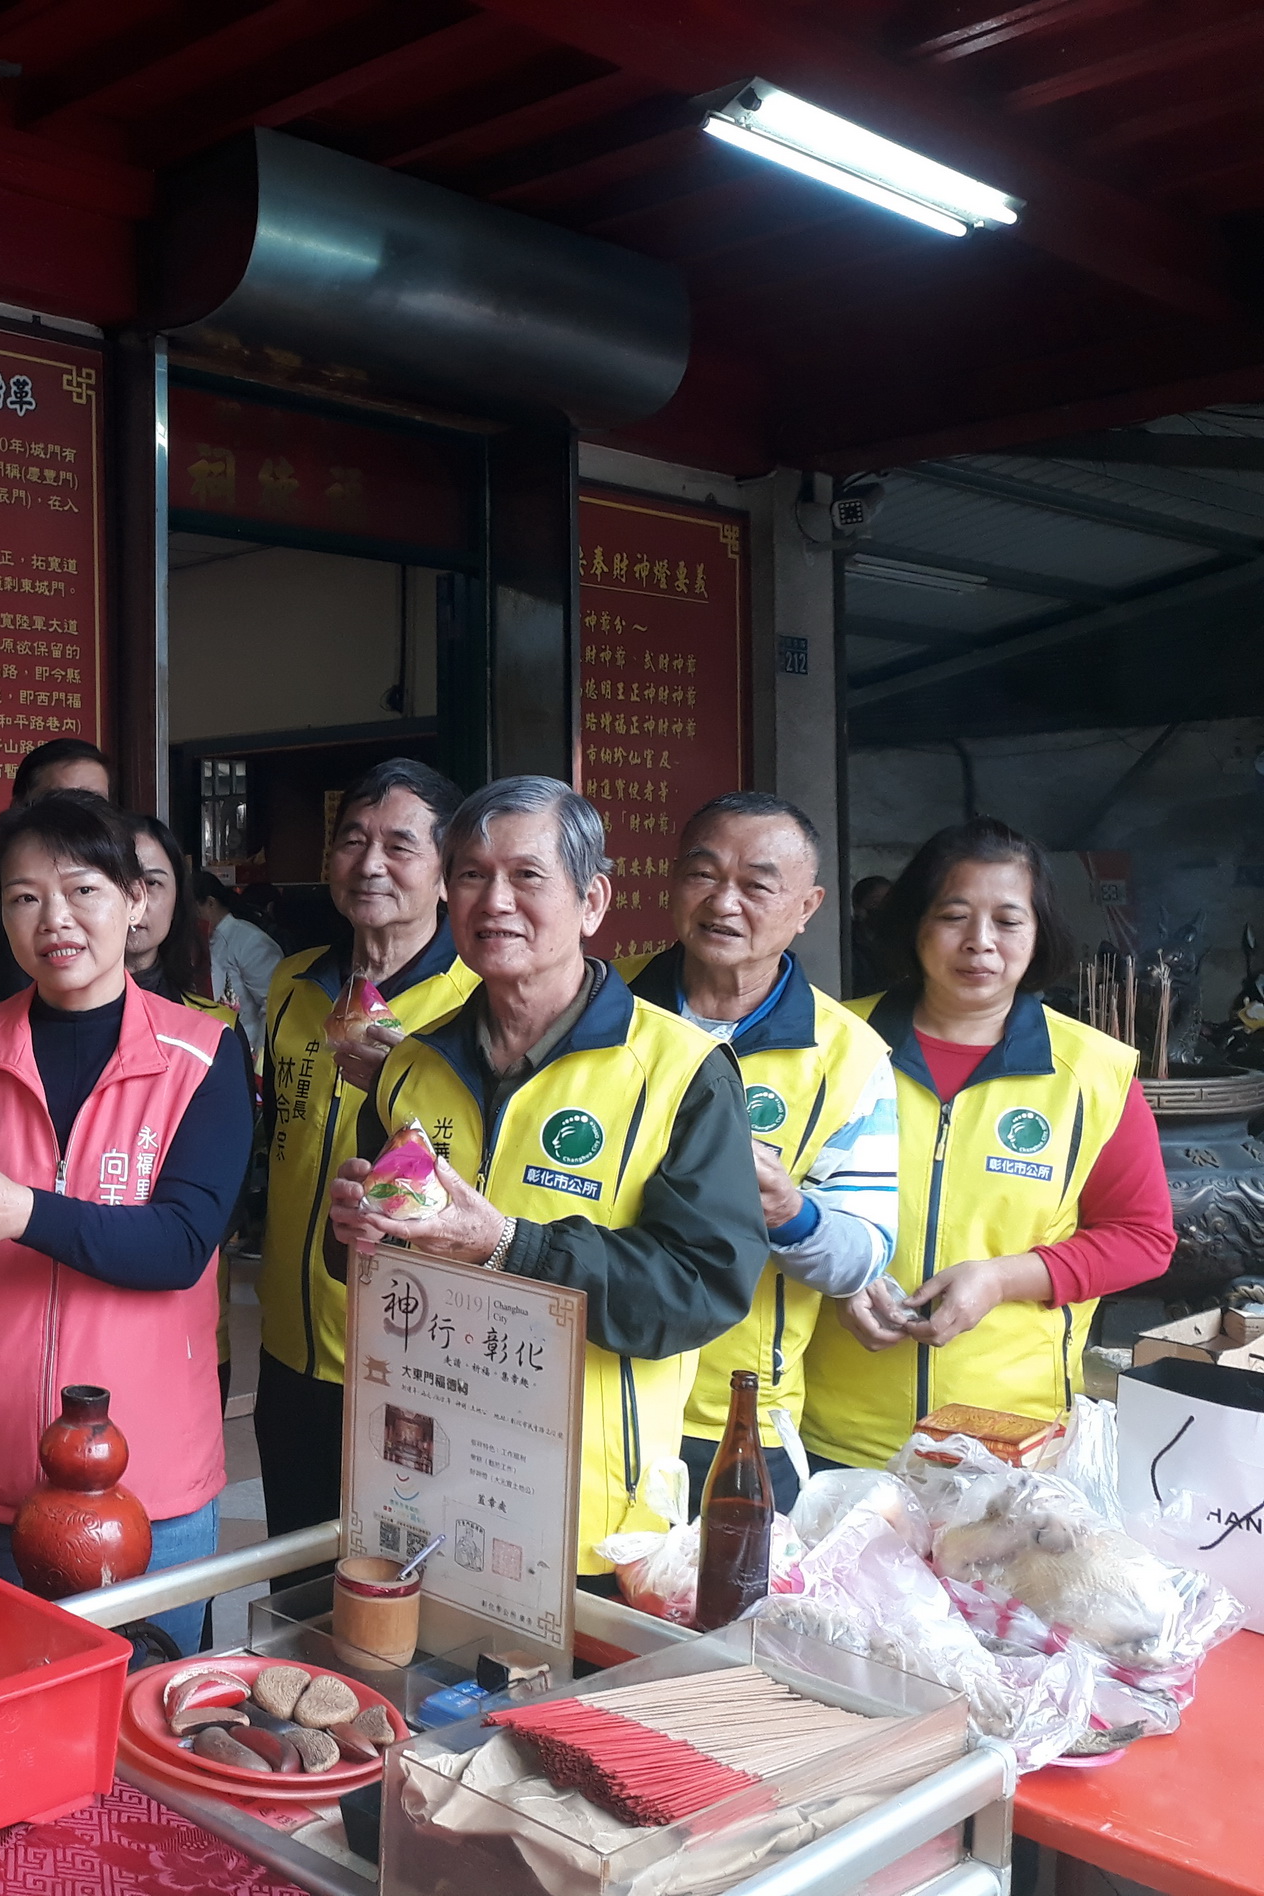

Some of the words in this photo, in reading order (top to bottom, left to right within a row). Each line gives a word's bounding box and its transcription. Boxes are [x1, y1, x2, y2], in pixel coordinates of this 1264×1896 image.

[785, 651, 806, 673] 212
[292, 1039, 320, 1121] 中正里長
[99, 1148, 130, 1206] 向玉
[134, 1126, 158, 1200] 永福里
[988, 1158, 1050, 1180] 彰化市公所
[525, 1168, 598, 1198] 彰化市公所
[444, 1288, 483, 1313] 2019
[493, 1300, 529, 1317] Changhua
[493, 1313, 508, 1325] City
